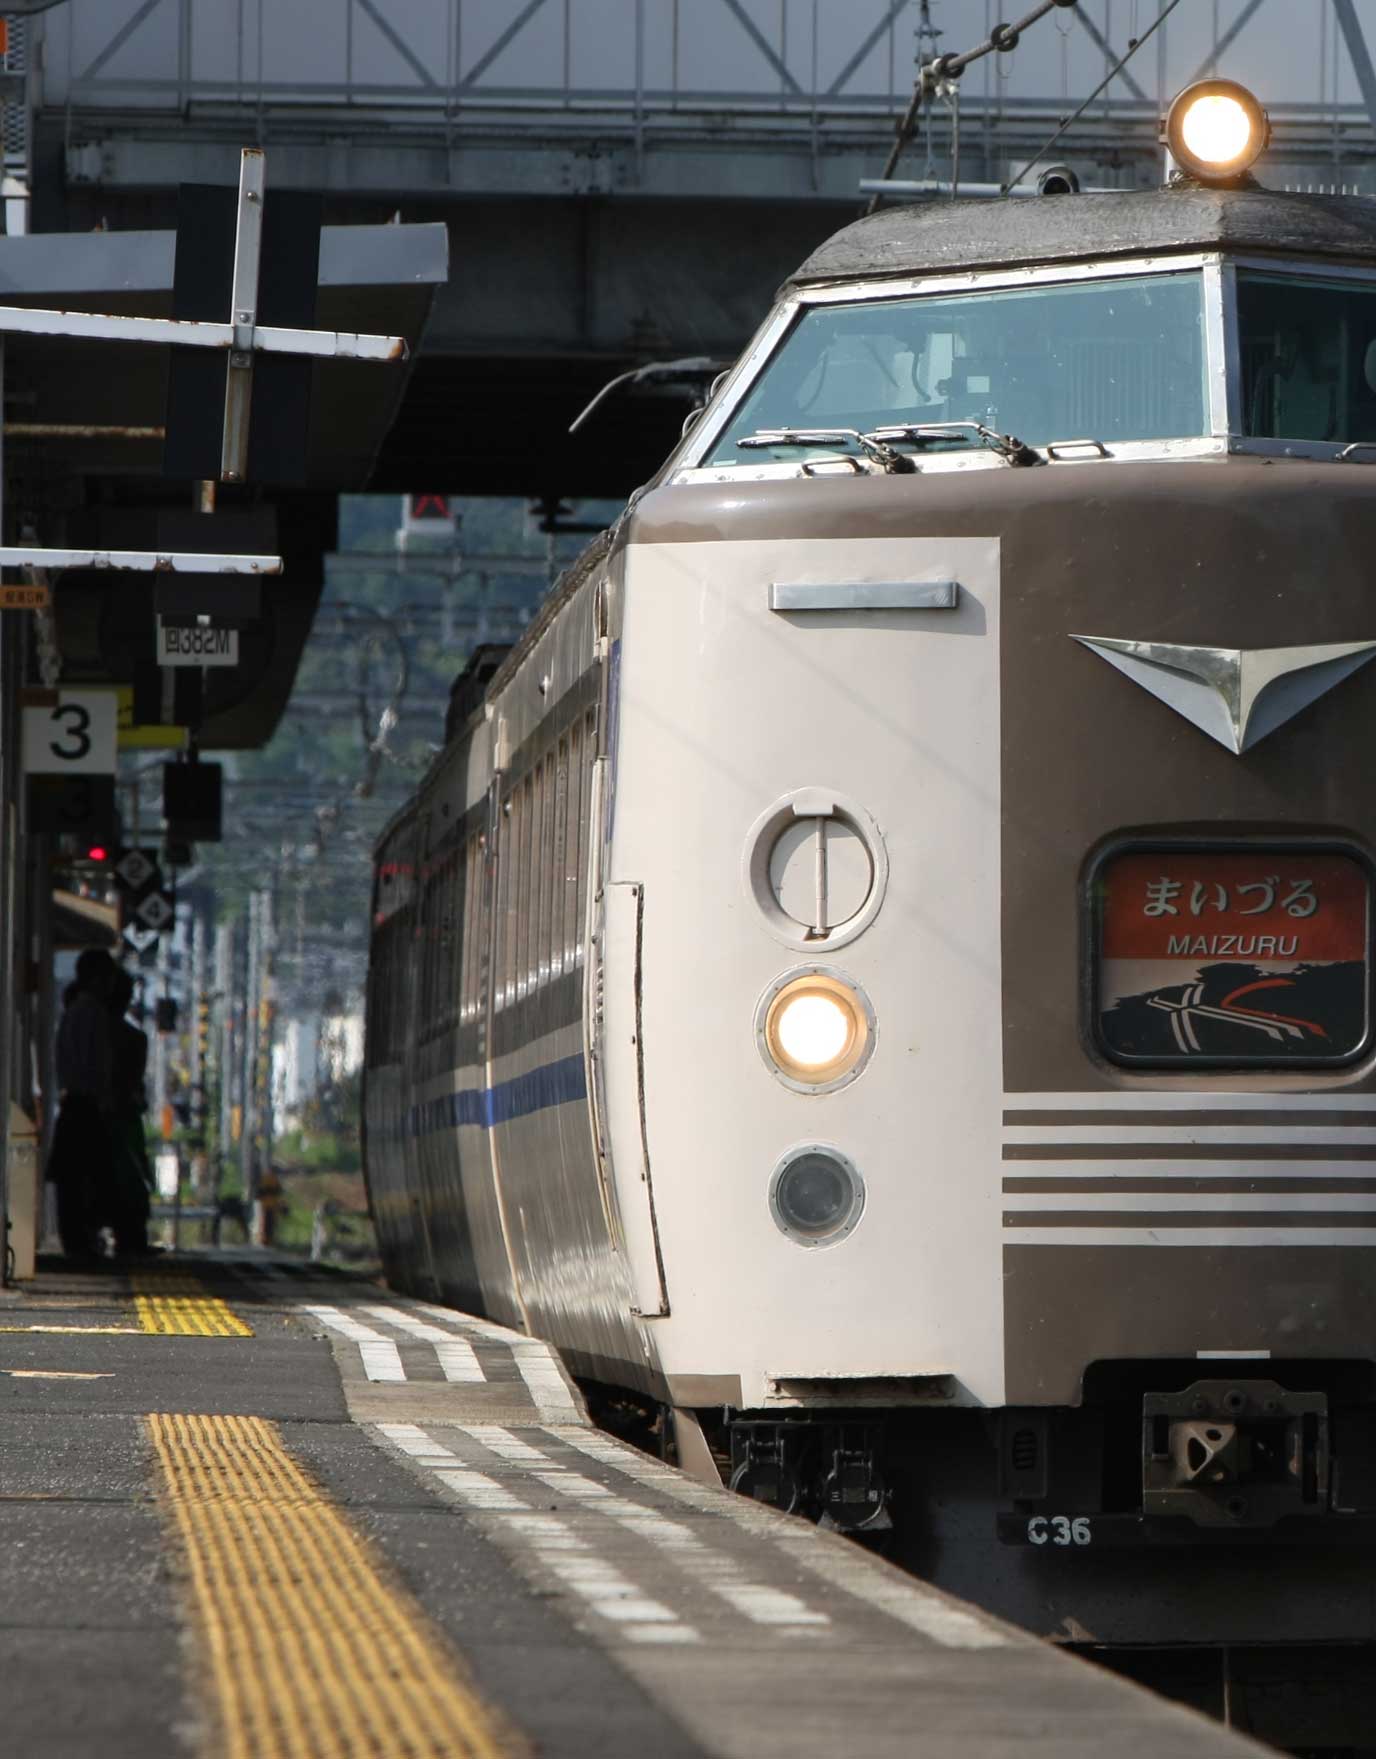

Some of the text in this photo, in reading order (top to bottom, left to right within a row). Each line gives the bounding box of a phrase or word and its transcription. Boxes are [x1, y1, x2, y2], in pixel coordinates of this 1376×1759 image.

[166, 627, 230, 655] 回382M
[51, 703, 91, 760] 3
[145, 900, 160, 919] 4
[1143, 875, 1318, 918] まいづる
[1167, 935, 1298, 956] MAIZURU
[1028, 1516, 1091, 1545] C36
